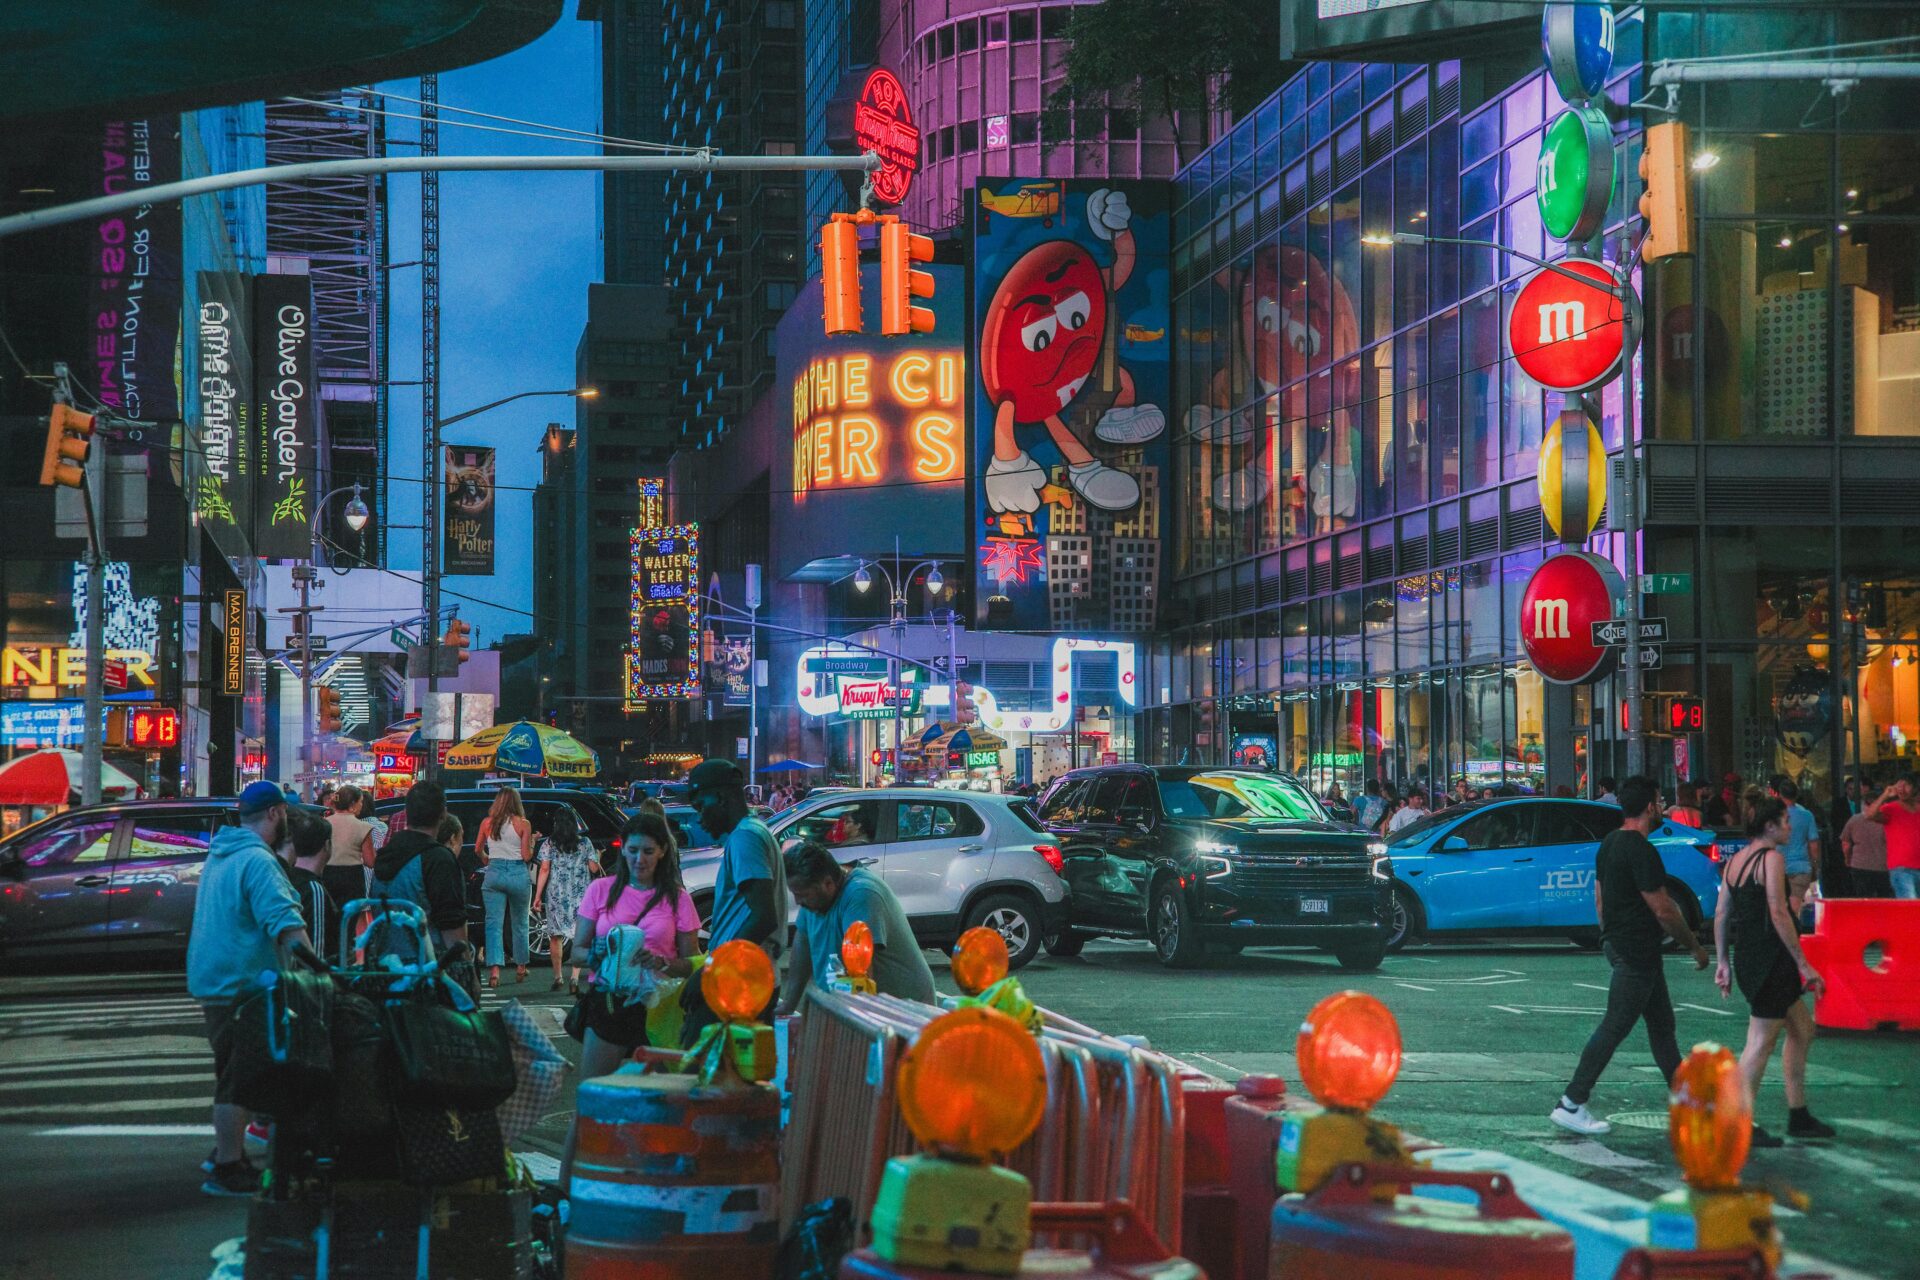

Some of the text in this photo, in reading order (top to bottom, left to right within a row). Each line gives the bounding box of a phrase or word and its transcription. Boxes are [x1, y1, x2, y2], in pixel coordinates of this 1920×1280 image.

[872, 81, 901, 110] HOT
[858, 136, 917, 169] ORIGINAL GLAZED
[1537, 148, 1557, 200] m
[1538, 300, 1588, 344] m
[271, 304, 306, 482] Olive Garden
[810, 357, 869, 413] THE
[794, 418, 879, 501] NEVER
[448, 518, 481, 540] Harry
[458, 534, 493, 553] Potter
[644, 554, 690, 569] WALTER
[650, 569, 683, 583] KERR
[1661, 577, 1668, 591] 7
[650, 584, 683, 599] Theatre
[1535, 598, 1570, 638] m
[229, 594, 241, 690] MAX BRENNER
[1603, 627, 1624, 639] ONE
[1, 647, 155, 685] NER
[825, 661, 869, 671] Broadway
[842, 683, 877, 708] Krispy
[383, 757, 394, 767] D
[1544, 890, 1581, 898] REQUEST
